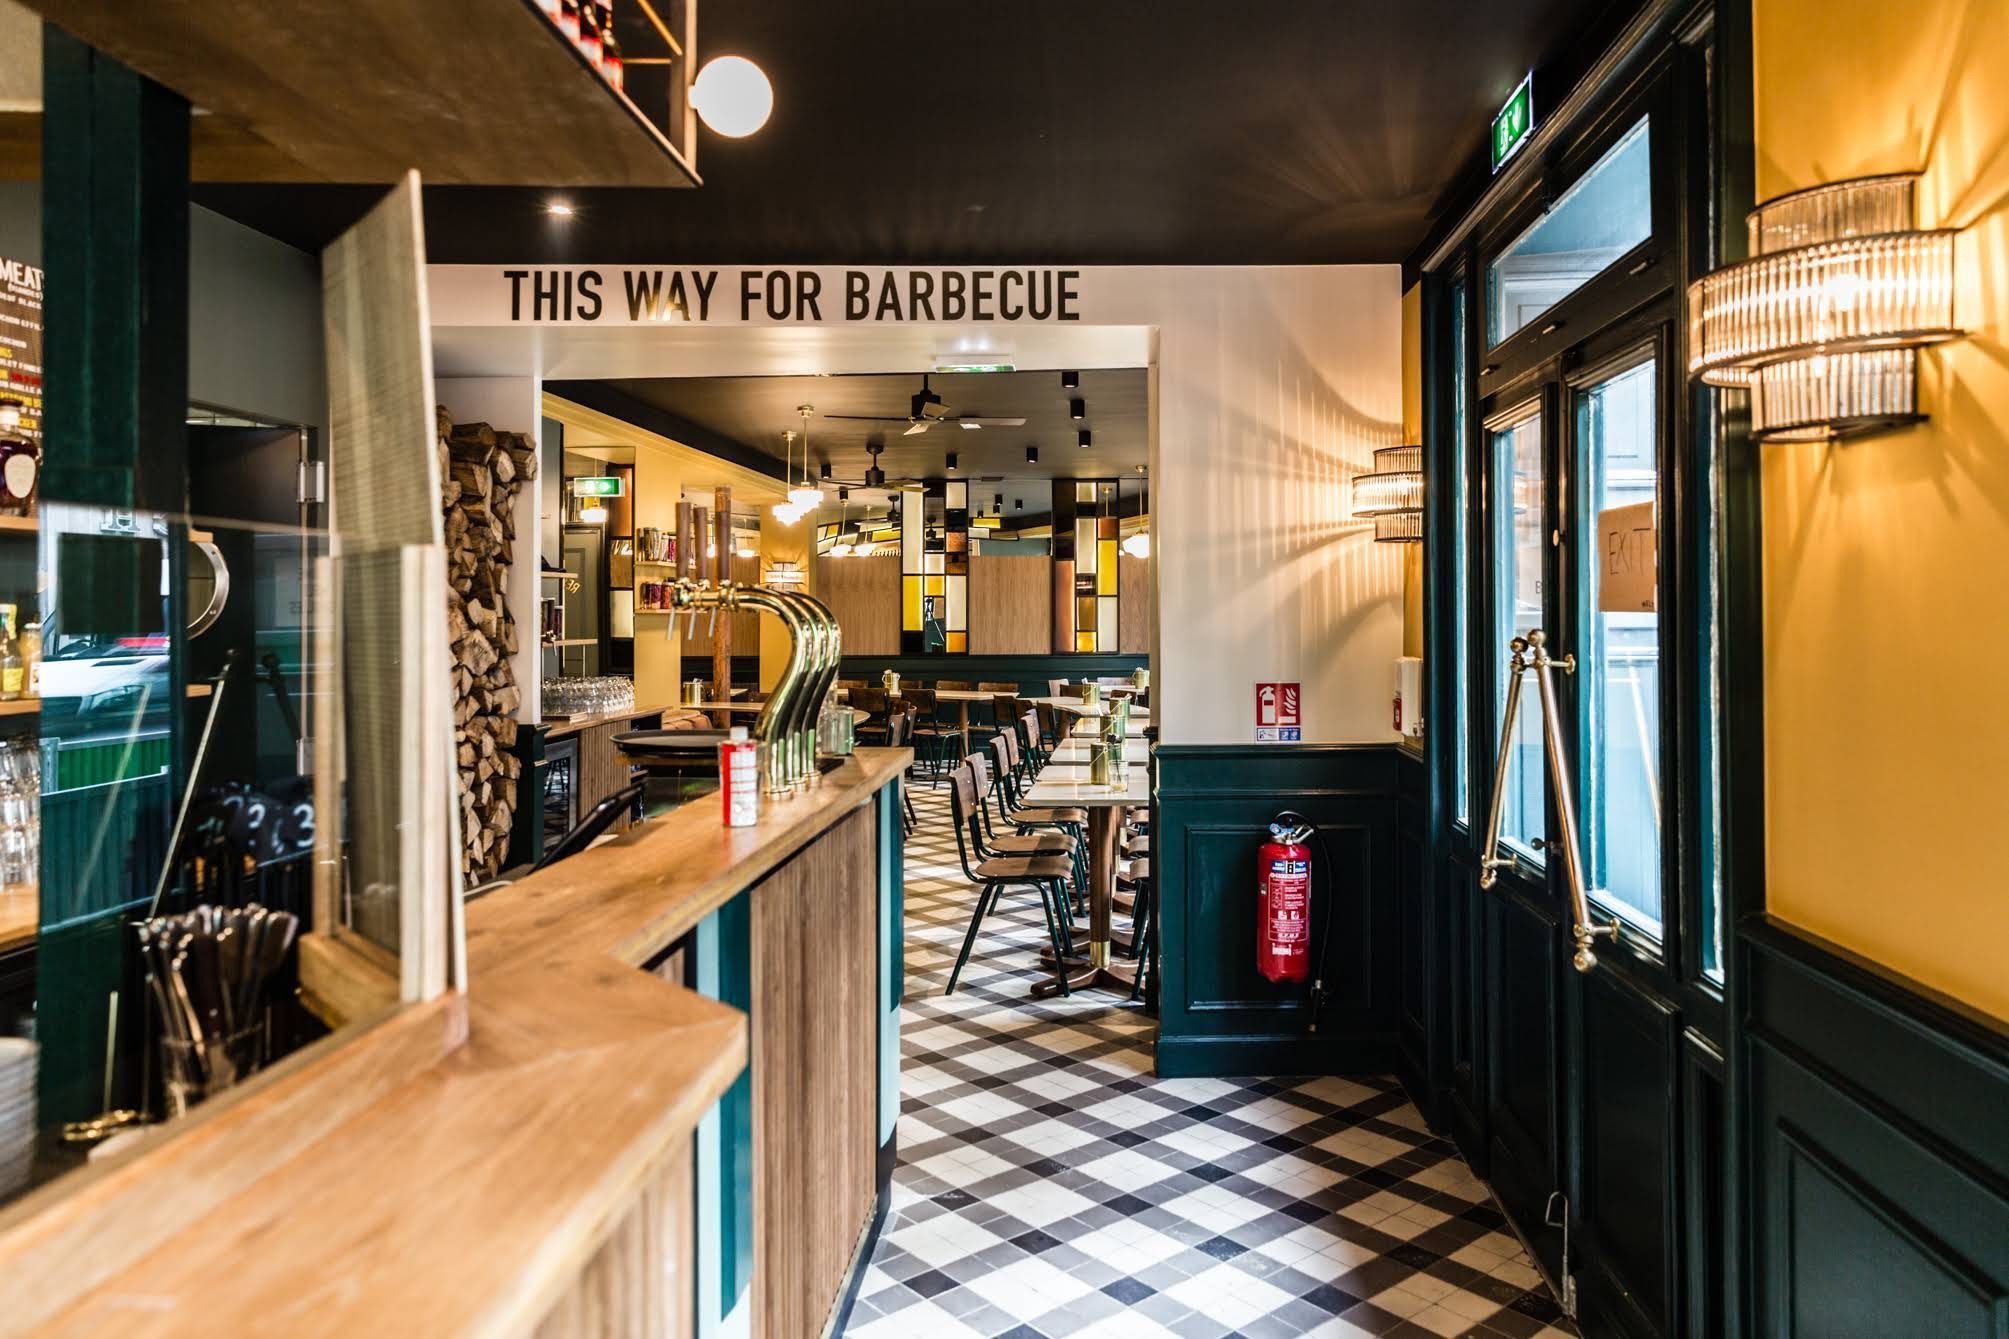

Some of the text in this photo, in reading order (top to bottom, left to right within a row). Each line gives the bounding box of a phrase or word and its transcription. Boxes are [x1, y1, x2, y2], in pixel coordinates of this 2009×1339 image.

[0, 256, 44, 291] MEAT
[503, 269, 1079, 320] THIS WAY FOR BARBECUE
[1608, 527, 1651, 576] EXIT
